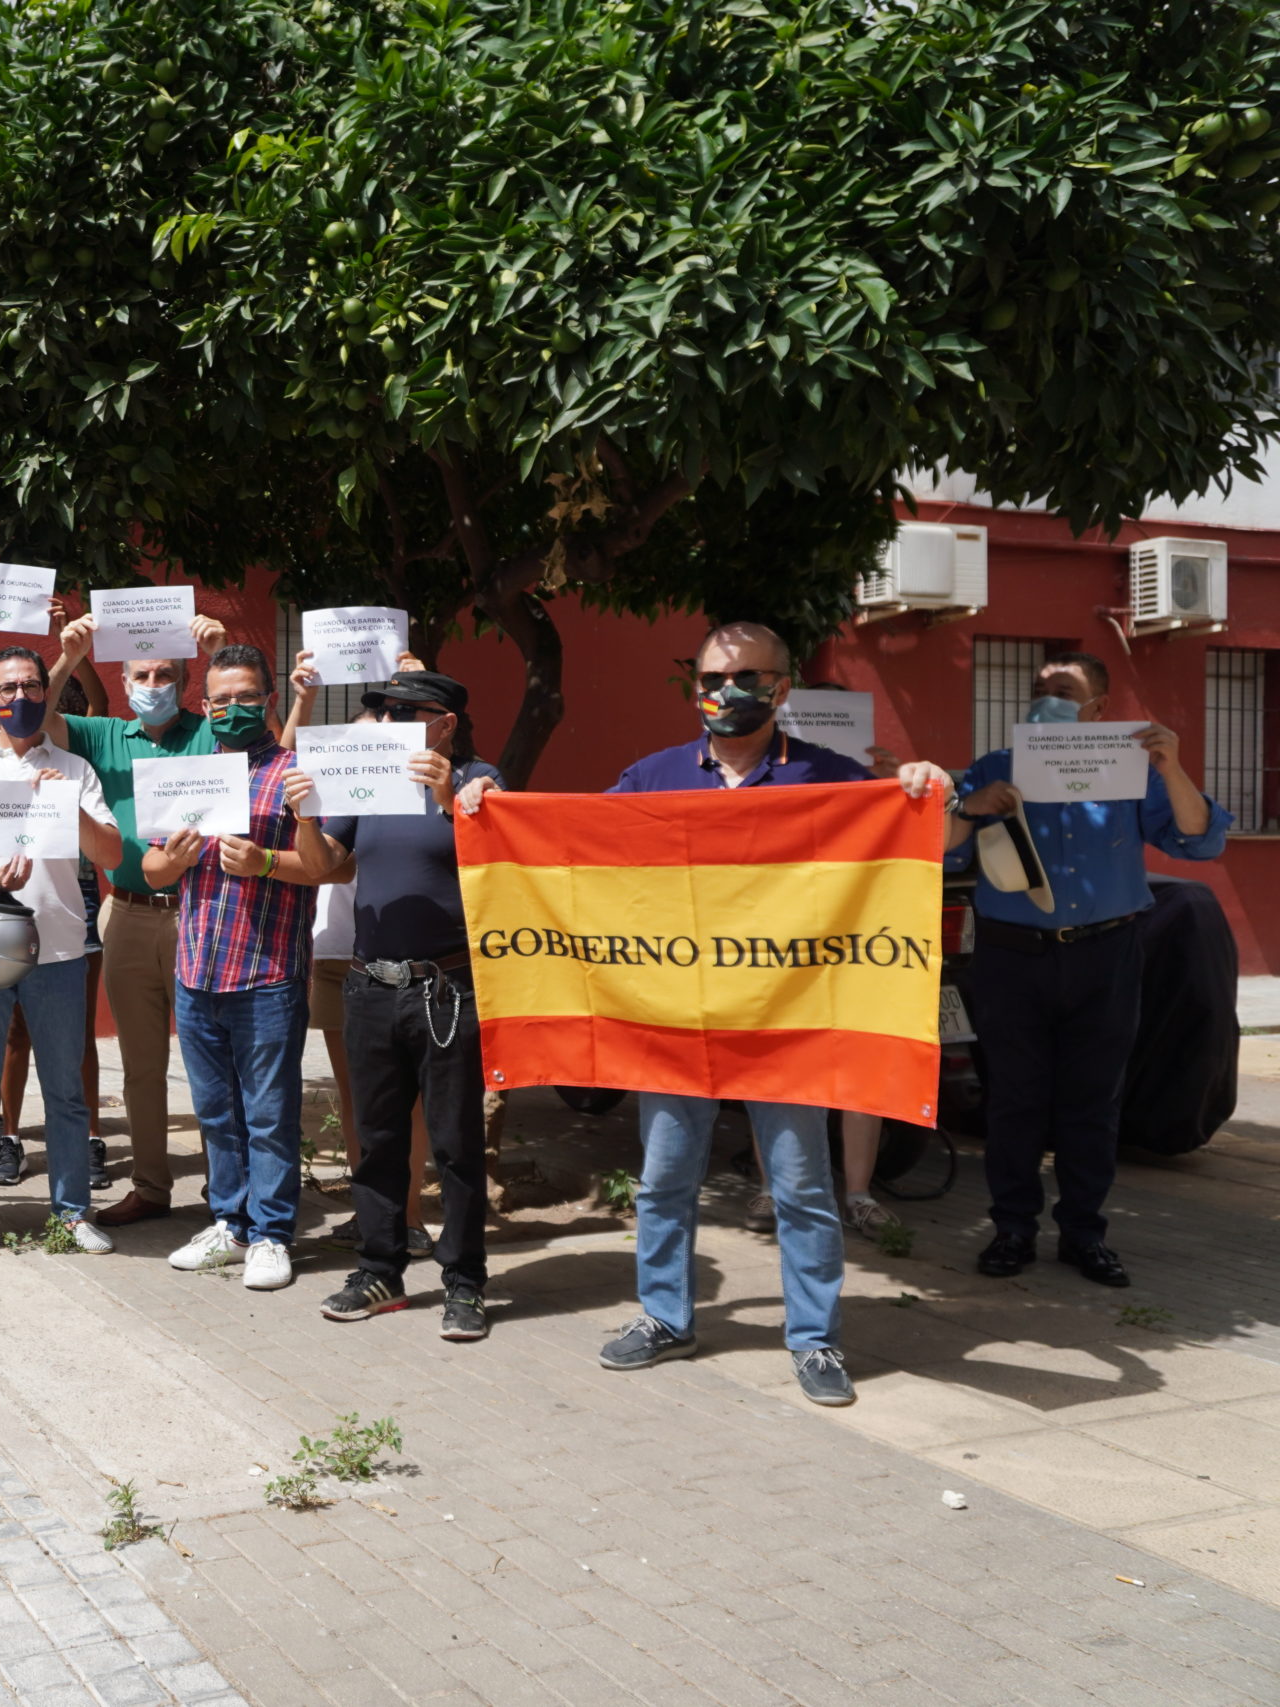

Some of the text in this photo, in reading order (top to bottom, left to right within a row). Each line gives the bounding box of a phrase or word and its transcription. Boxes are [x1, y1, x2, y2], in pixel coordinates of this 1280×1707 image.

[135, 641, 156, 651] VOX
[346, 662, 367, 672] VOX
[309, 744, 359, 753] POLÍTICOS
[361, 744, 374, 752] DE
[1040, 743, 1071, 751] VECINO
[320, 765, 401, 776] VOX DE FRENTE
[158, 781, 174, 789] LOS
[1066, 781, 1091, 791] VOX
[153, 787, 231, 797] TENDRÁN ENFRENTE
[349, 787, 375, 799] VOX
[181, 812, 205, 823] VOX
[15, 834, 35, 845] VOX
[480, 926, 933, 972] GOBIERNO DIMISIÓN
